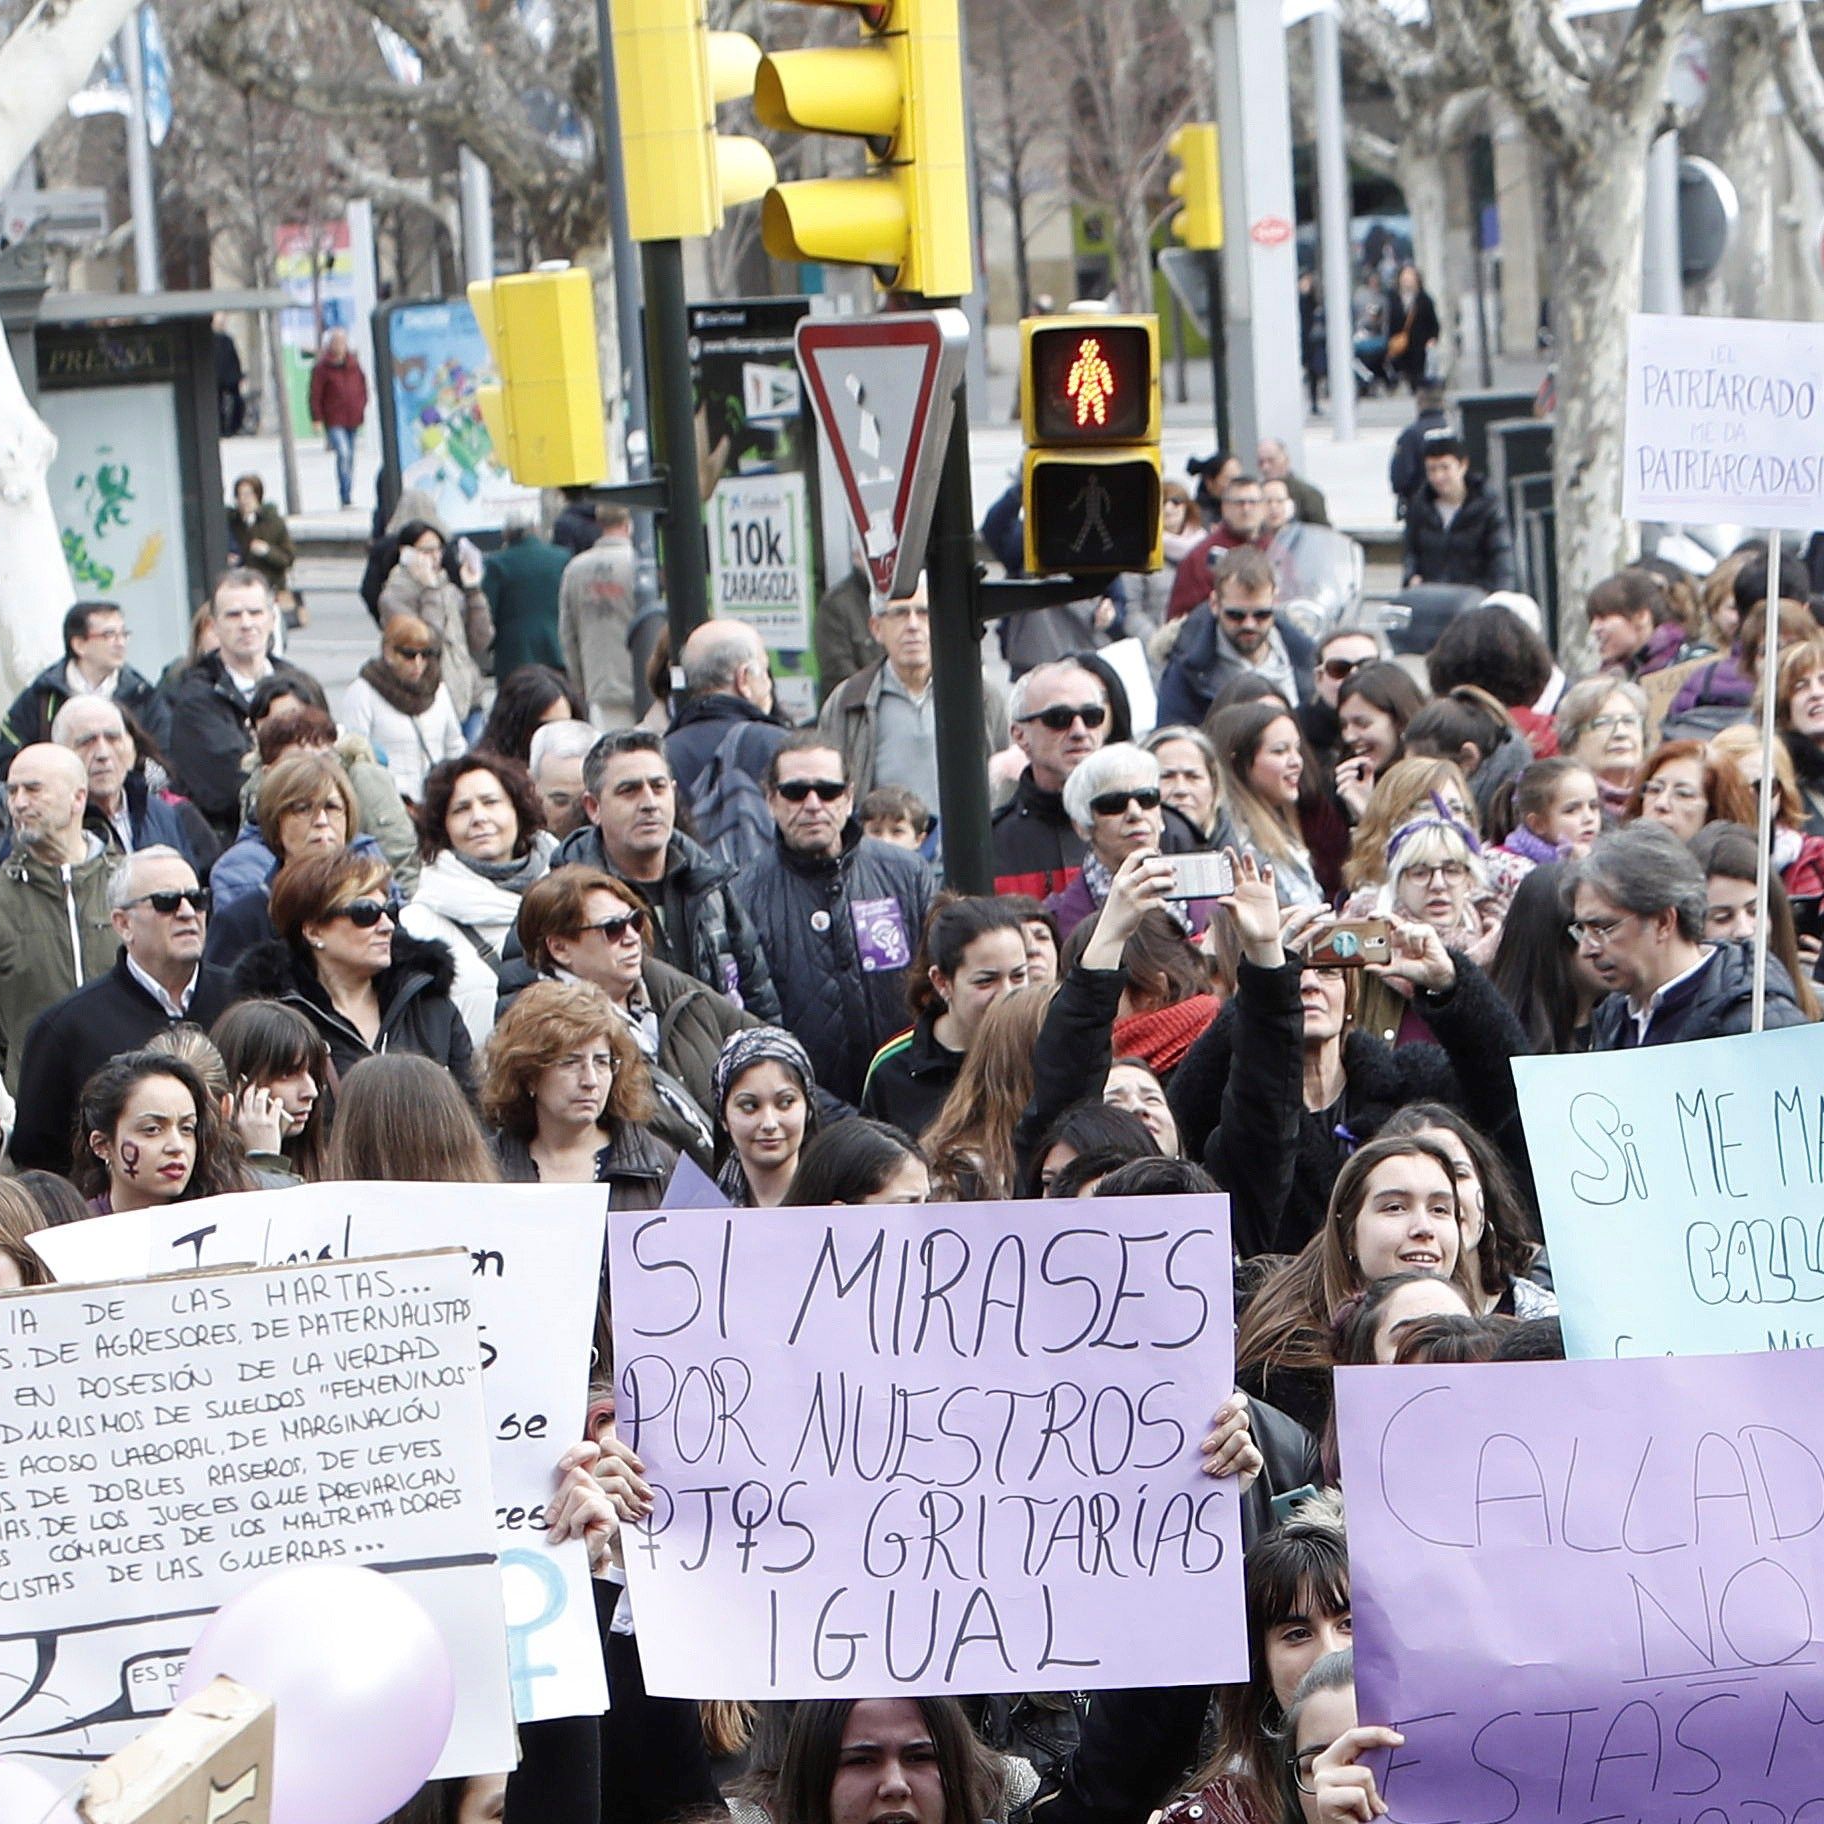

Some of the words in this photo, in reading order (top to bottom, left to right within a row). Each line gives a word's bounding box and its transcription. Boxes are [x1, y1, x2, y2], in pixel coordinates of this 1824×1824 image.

[48, 346, 157, 374] PRENSA
[1642, 365, 1815, 420] PATRIARCADO
[1690, 422, 1717, 441] ME
[1723, 423, 1747, 443] DA
[730, 517, 784, 567] 10k
[721, 569, 798, 603] ZARAGOZA
[1675, 1088, 1748, 1198] ME
[82, 1301, 125, 1326] DE
[172, 1288, 231, 1314] LAS
[632, 1215, 733, 1339] SI
[788, 1225, 1214, 1358] MIRASES
[28, 1342, 79, 1368] DE
[251, 1318, 290, 1340] DE
[298, 1298, 472, 1337] PATERNALISTAS
[14, 1384, 55, 1407] EN
[78, 1364, 212, 1400] POSESIÓN
[238, 1360, 276, 1383] DE
[292, 1353, 323, 1376] LA
[334, 1336, 440, 1372] VERDAD
[155, 1406, 190, 1427] DE
[205, 1387, 306, 1419] SUELDOS
[20, 1453, 97, 1477] ACOSO
[227, 1428, 268, 1451] DE
[281, 1398, 440, 1441] MARGINACIÓN
[622, 1354, 768, 1467] POR
[791, 1370, 1185, 1488] NUESTROS
[26, 1487, 70, 1510] DE
[88, 1477, 184, 1503] DOBLES
[317, 1449, 359, 1471] DE
[368, 1439, 443, 1465] LEYES
[40, 1516, 77, 1538] DE
[90, 1510, 128, 1532] LOS
[148, 1497, 238, 1526] JUECES
[251, 1485, 308, 1511] QUE
[317, 1467, 455, 1506] PREVARICAN
[49, 1533, 164, 1563] CÓMPLICES
[183, 1526, 215, 1547] DE
[231, 1518, 265, 1538] LOS
[282, 1489, 462, 1531] MALTRATADORES
[862, 1482, 1226, 1582] GRITARÍAS
[106, 1563, 143, 1584] DE
[157, 1556, 203, 1583] LAS
[770, 1584, 1101, 1688] IGUAL
[1626, 1556, 1814, 1678] NO
[132, 1667, 159, 1684] ES
